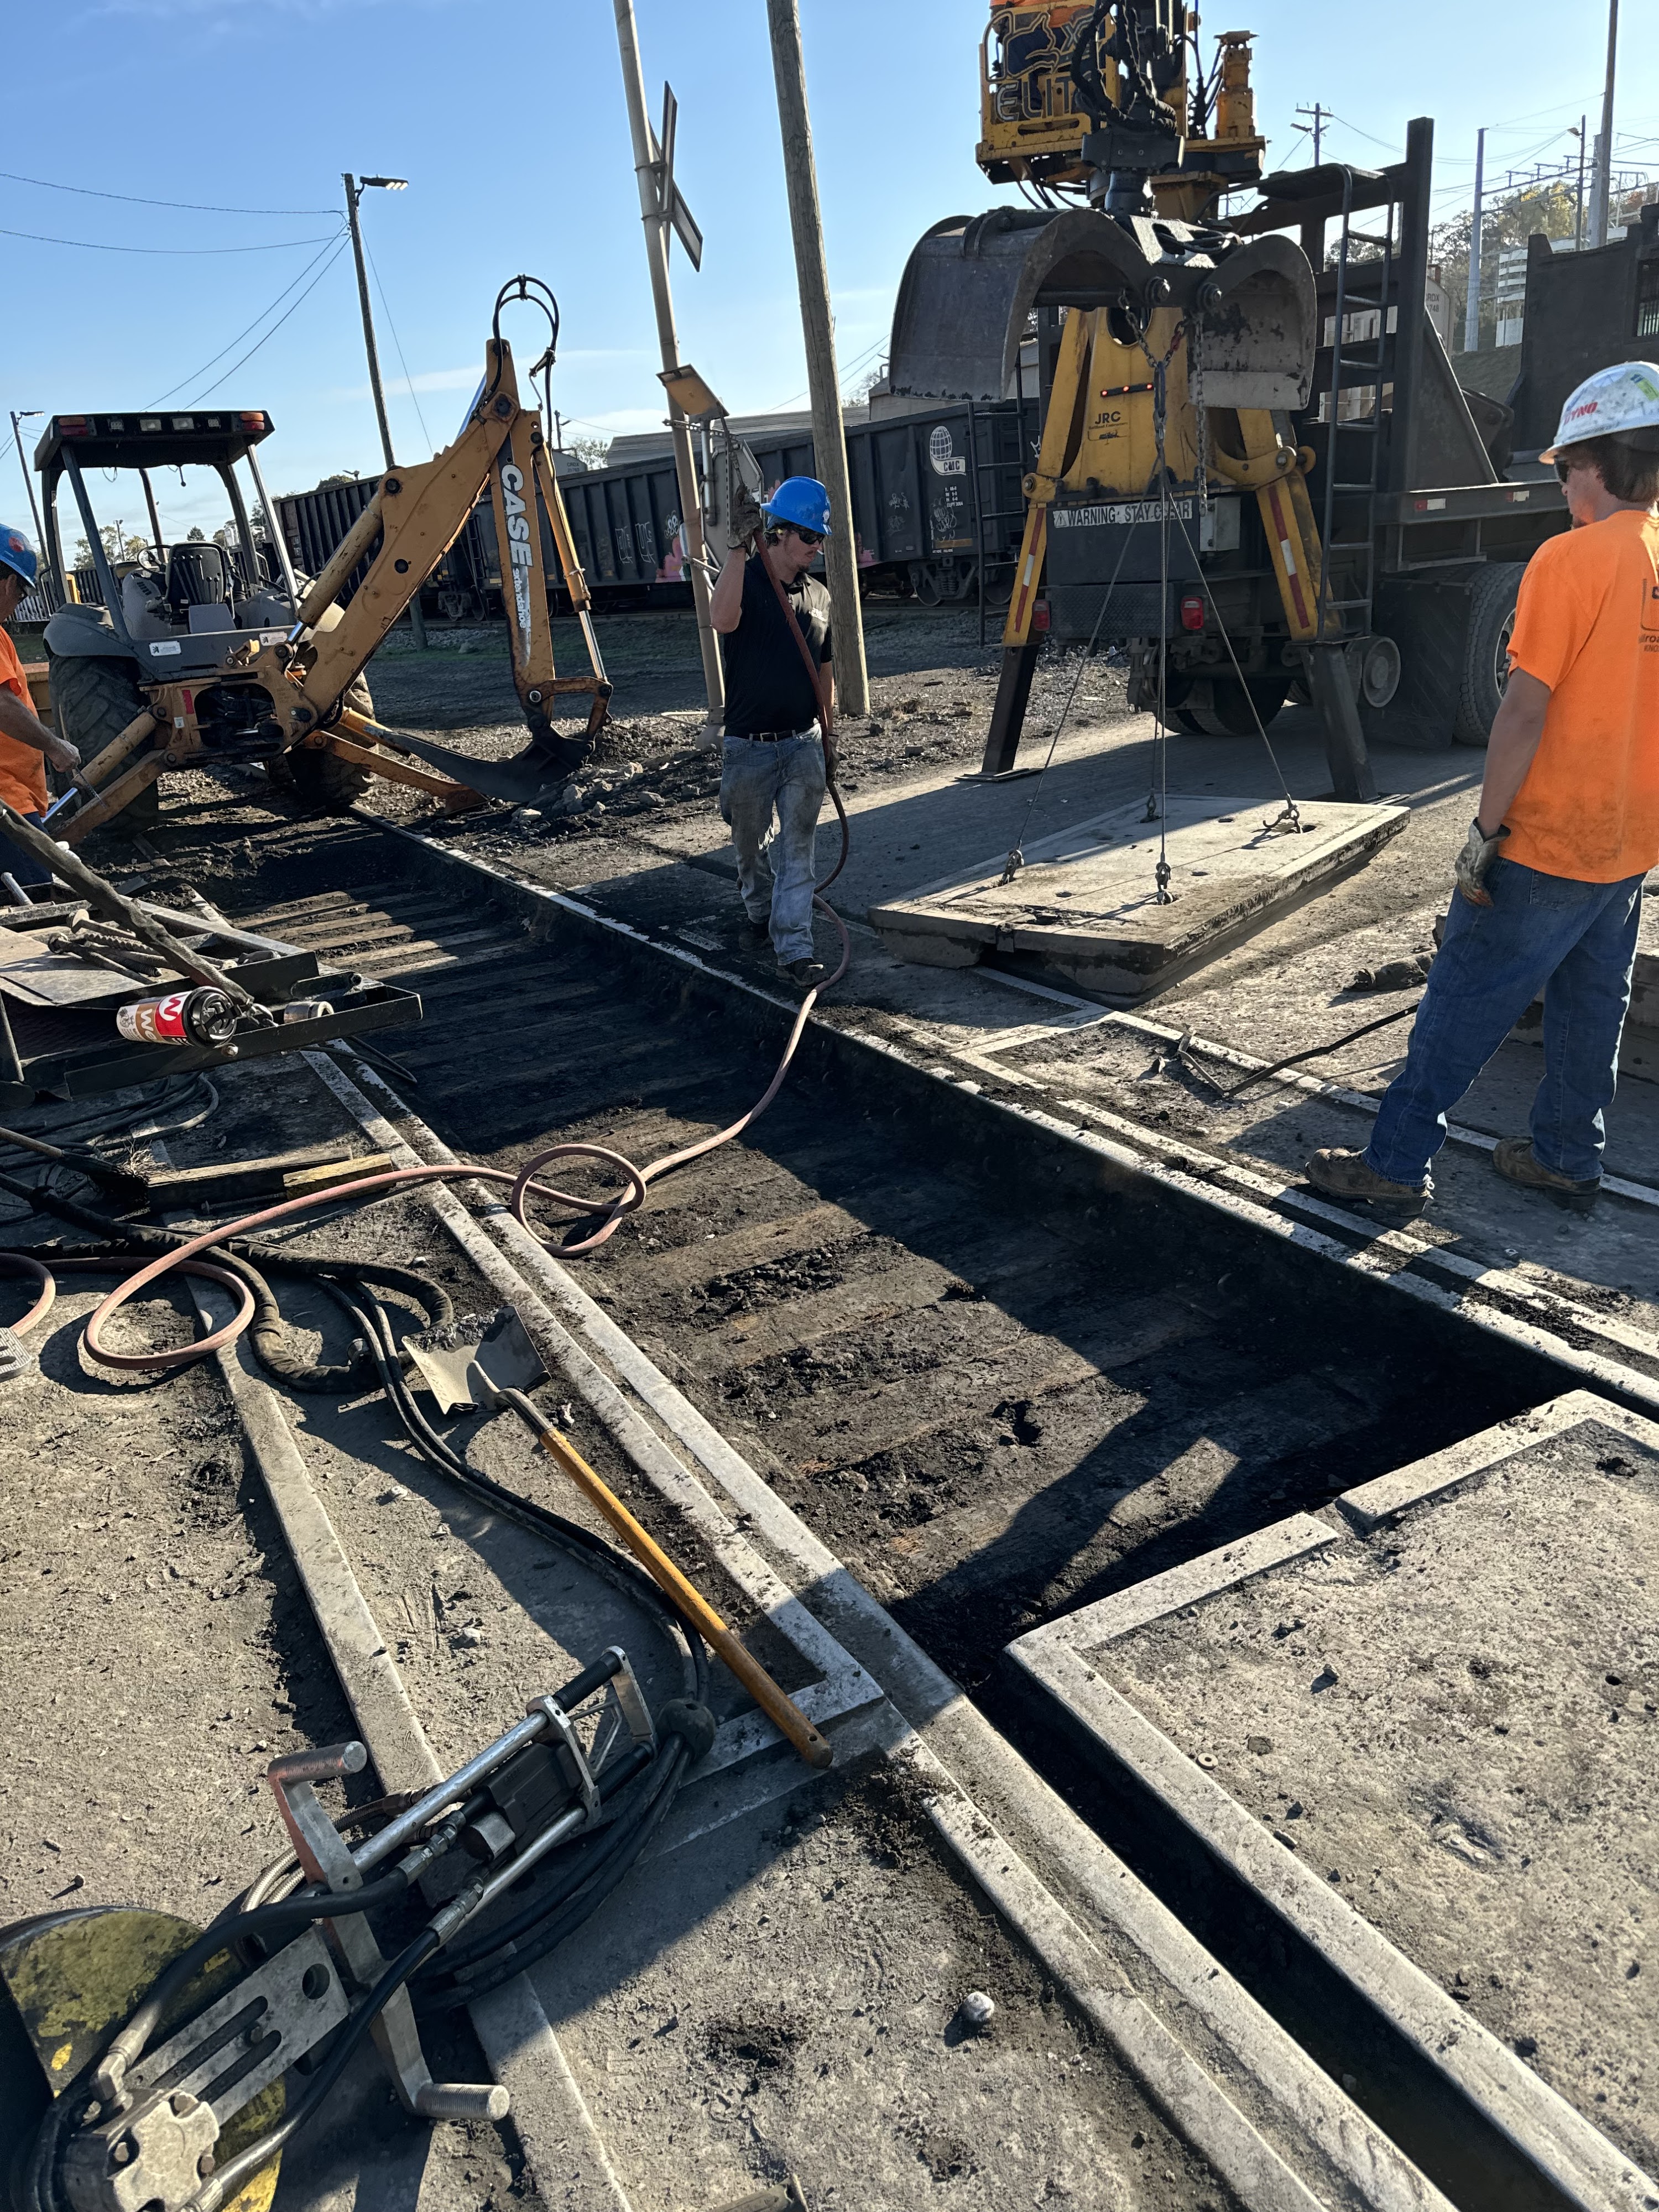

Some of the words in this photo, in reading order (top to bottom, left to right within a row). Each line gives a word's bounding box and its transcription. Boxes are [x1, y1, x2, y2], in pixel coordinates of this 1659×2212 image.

[1094, 411, 1121, 425] JRC
[943, 460, 960, 472] CMC
[502, 464, 533, 566] CASE
[1067, 507, 1115, 526] WARNING
[1125, 503, 1151, 523] STAY
[512, 567, 526, 629] extendahoe
